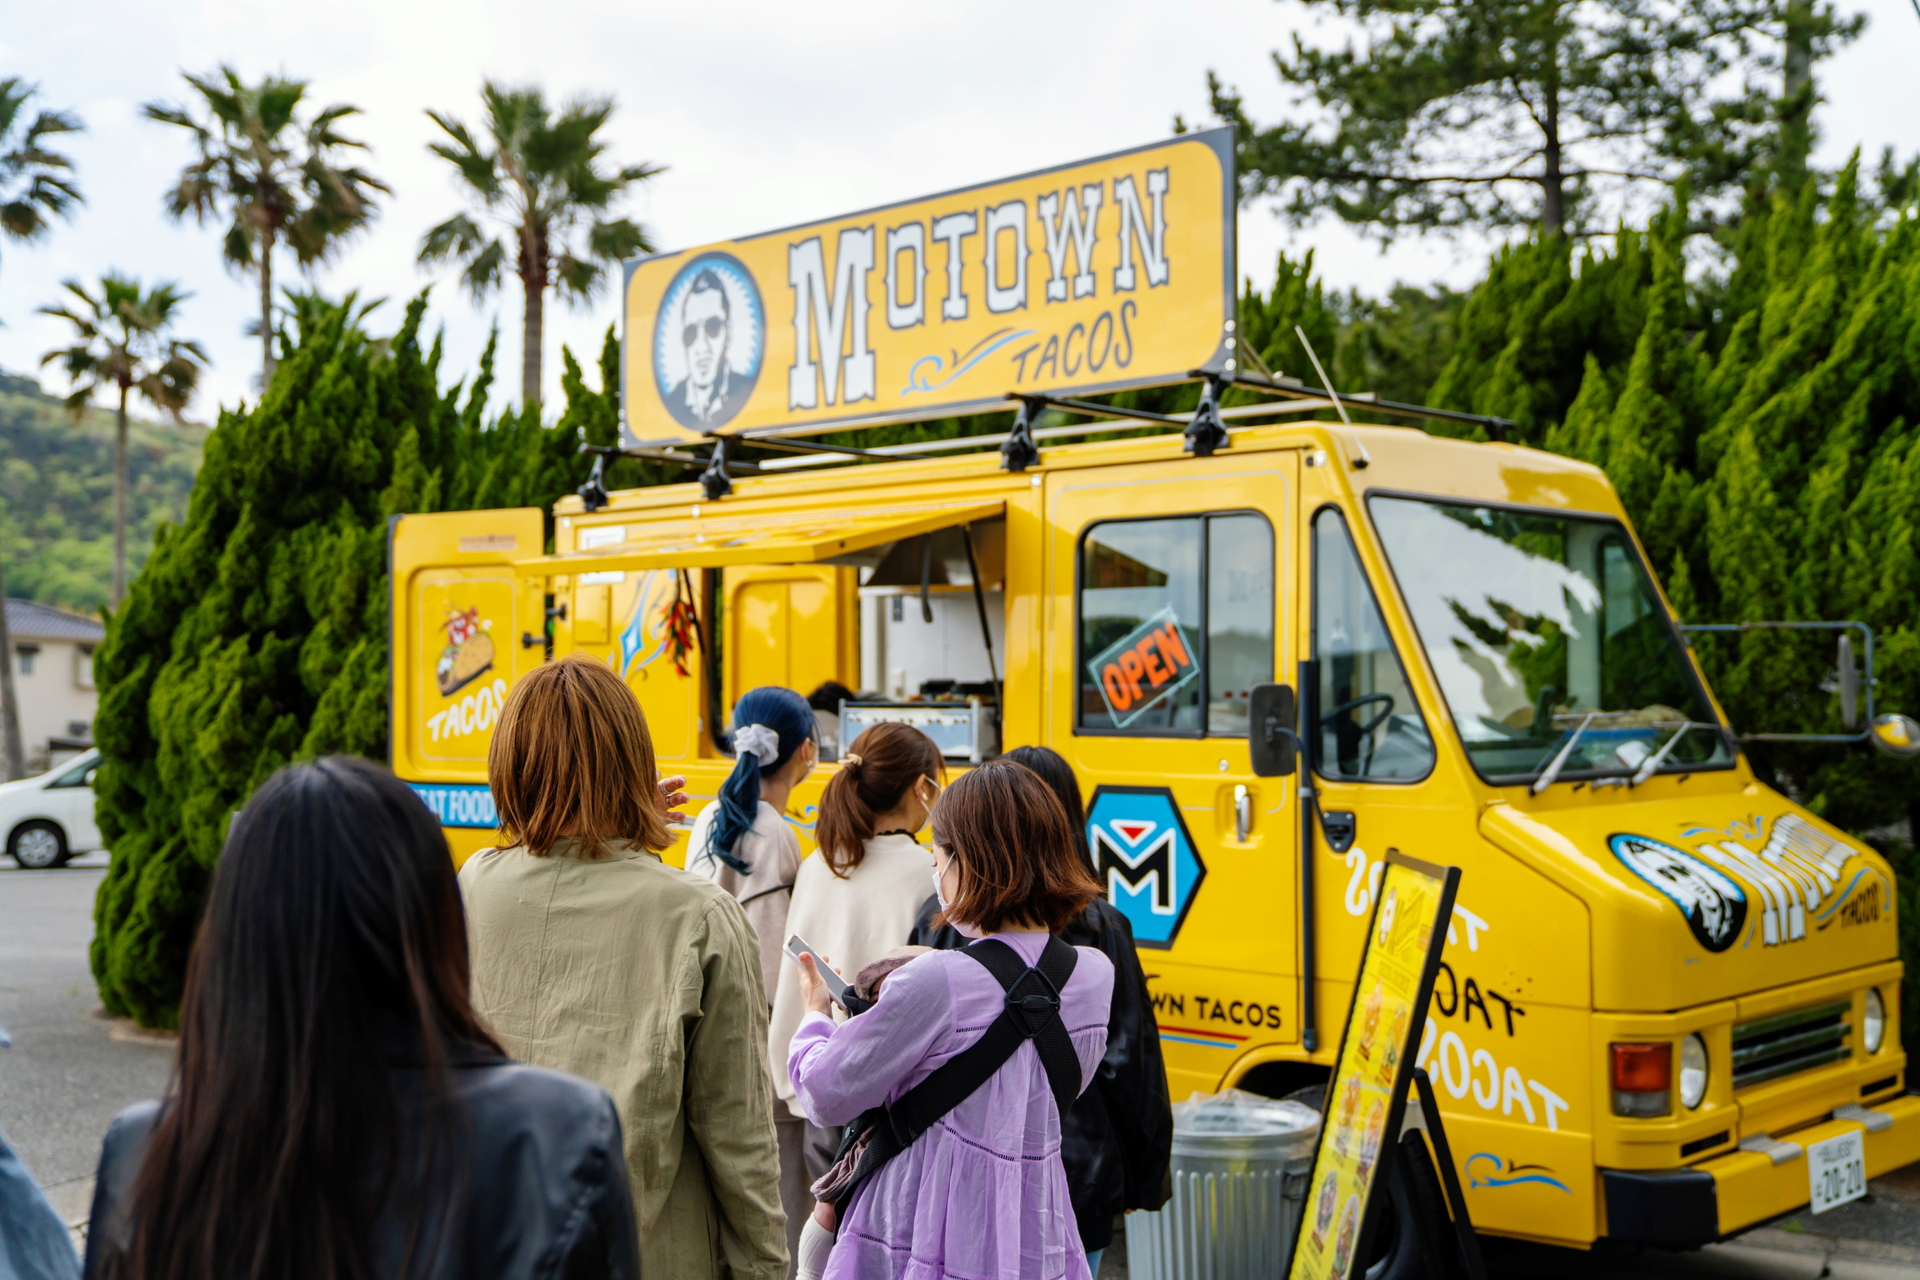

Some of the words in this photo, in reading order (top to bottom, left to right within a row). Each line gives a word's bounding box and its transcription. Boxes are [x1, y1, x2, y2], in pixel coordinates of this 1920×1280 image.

[788, 166, 1171, 412] MOTOWN
[1011, 299, 1138, 385] TACOS
[1102, 620, 1191, 712] OPEN
[426, 678, 506, 742] TACOS
[448, 788, 497, 823] FOOD
[1194, 995, 1281, 1029] TACOS
[1823, 1158, 1863, 1204] 20-20
